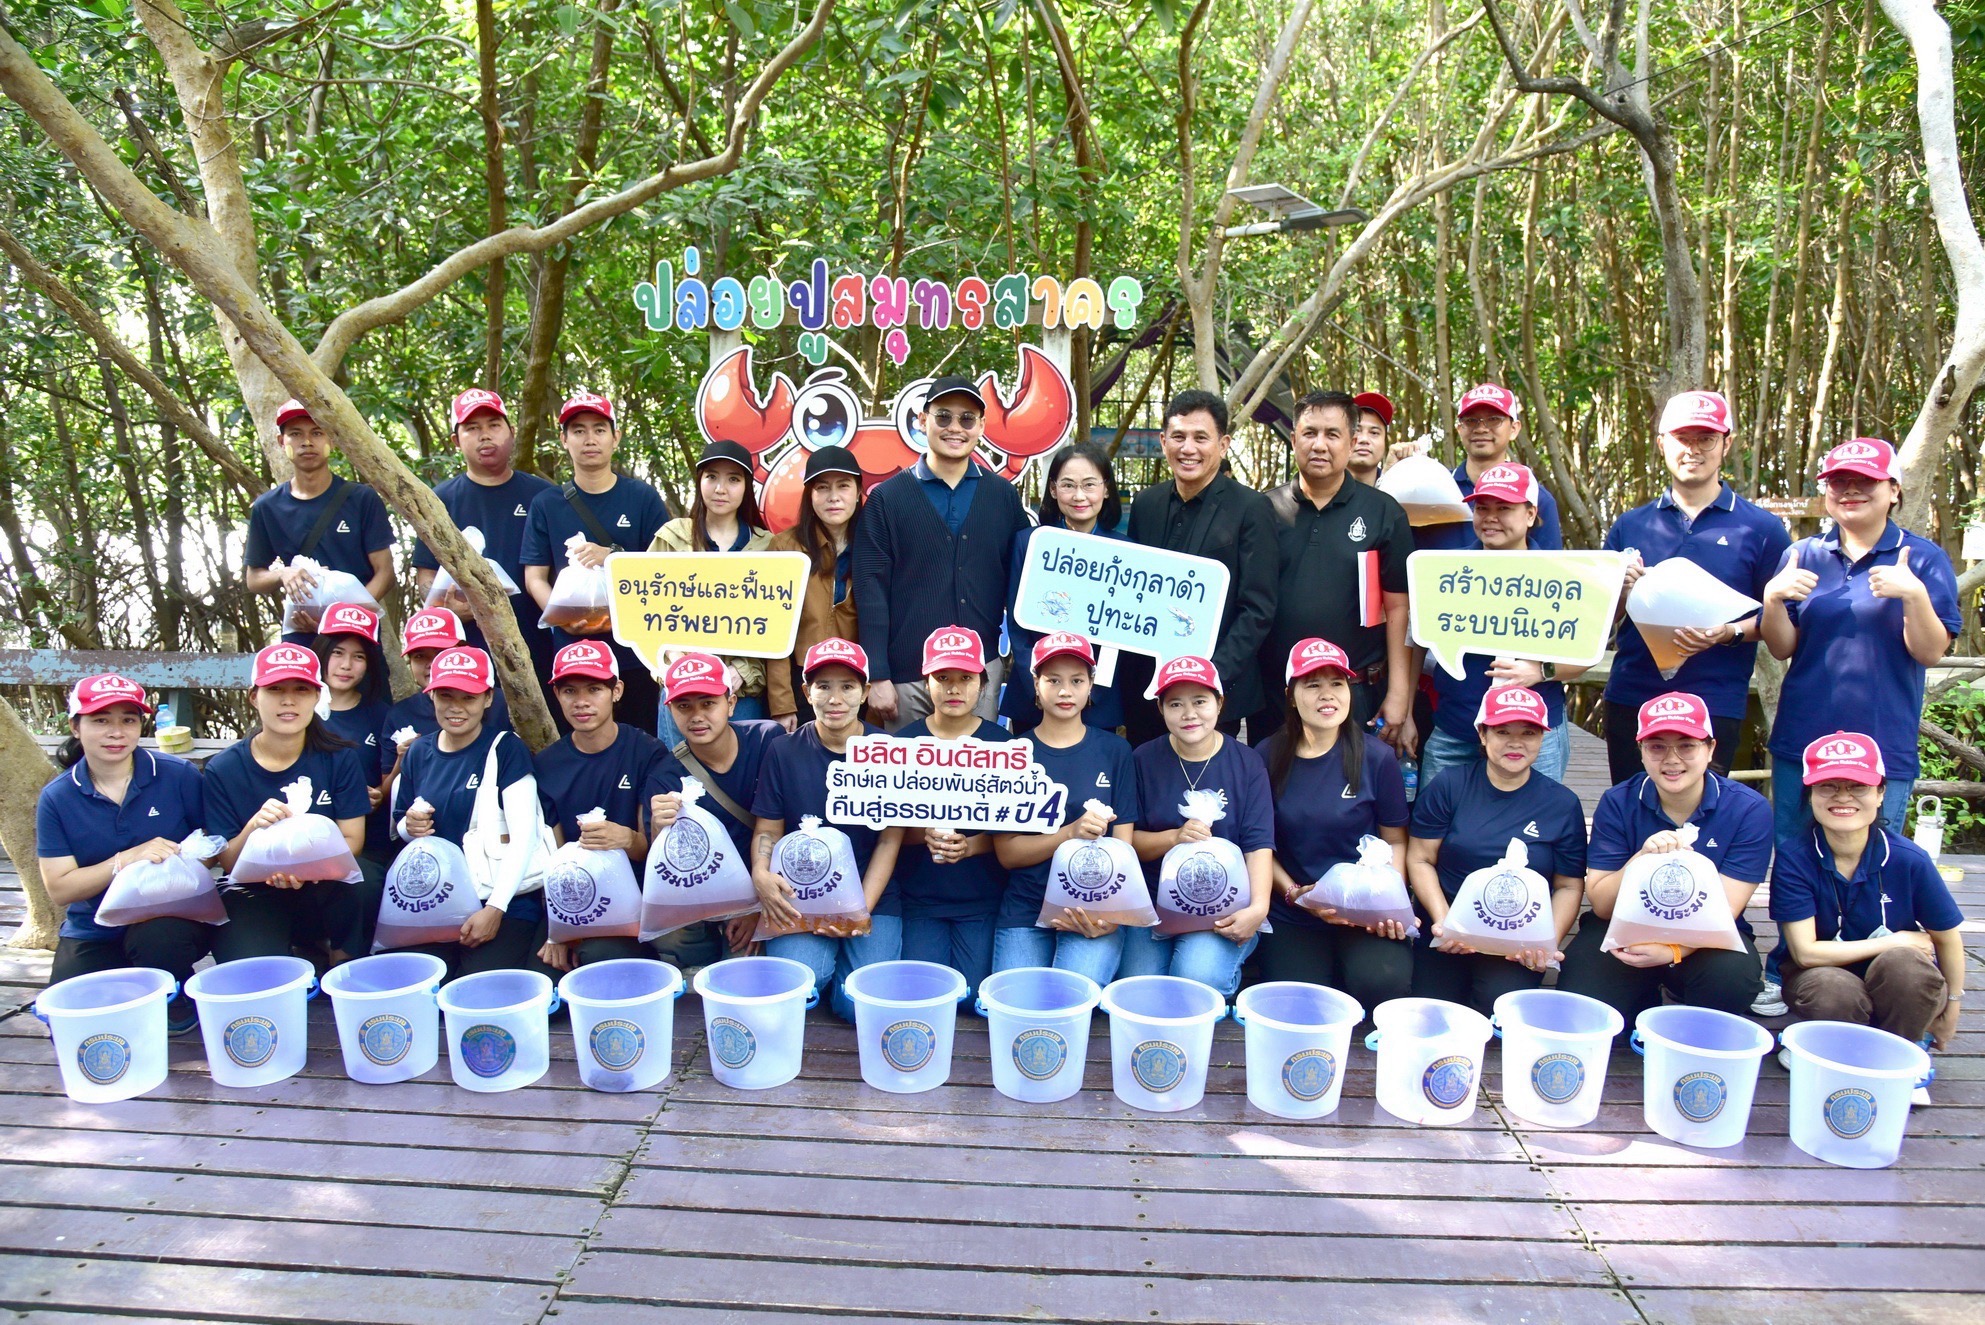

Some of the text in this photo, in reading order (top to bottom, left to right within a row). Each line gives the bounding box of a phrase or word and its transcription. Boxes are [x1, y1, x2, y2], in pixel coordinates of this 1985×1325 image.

[634, 246, 1143, 366] ปล่อยปูสมุทรสาคร
[618, 569, 793, 611] อนุรักษ์และฟื้นฟู
[1042, 547, 1205, 604] ปล่อยกุ้งกุลาดำ
[1439, 565, 1582, 613] สร้างสมดุล
[342, 610, 366, 623] POP
[415, 615, 437, 631] POP
[644, 604, 768, 636] ทรัพยากร
[1087, 600, 1158, 637] ปูทะเล
[1438, 607, 1579, 641] ระบบนิเวศ
[275, 649, 303, 662] POP
[567, 646, 594, 660] POP
[823, 641, 850, 652] POP
[939, 635, 965, 649] POP
[1308, 643, 1333, 655] POP
[444, 654, 471, 667] POP
[678, 661, 704, 676] POP
[1171, 659, 1197, 671] POP
[100, 677, 129, 690] POP
[1504, 691, 1531, 704] POP
[1656, 699, 1684, 712] POP
[853, 741, 1027, 770] ชลิต อินดัสทรี
[1825, 742, 1856, 757] POP
[832, 768, 1047, 799] รักษ์เล ปล่อยพันธุ์สัตว์น้ำ
[832, 795, 989, 824] คืนสู่ธรรมชาติ
[654, 851, 724, 888] กรมประมง
[388, 882, 454, 913] กรมประมง
[1057, 871, 1126, 902] กรมประมง
[1169, 886, 1238, 917] กรมประมง
[1473, 900, 1542, 931] กรมประมง
[1639, 889, 1708, 921] กรมประมง
